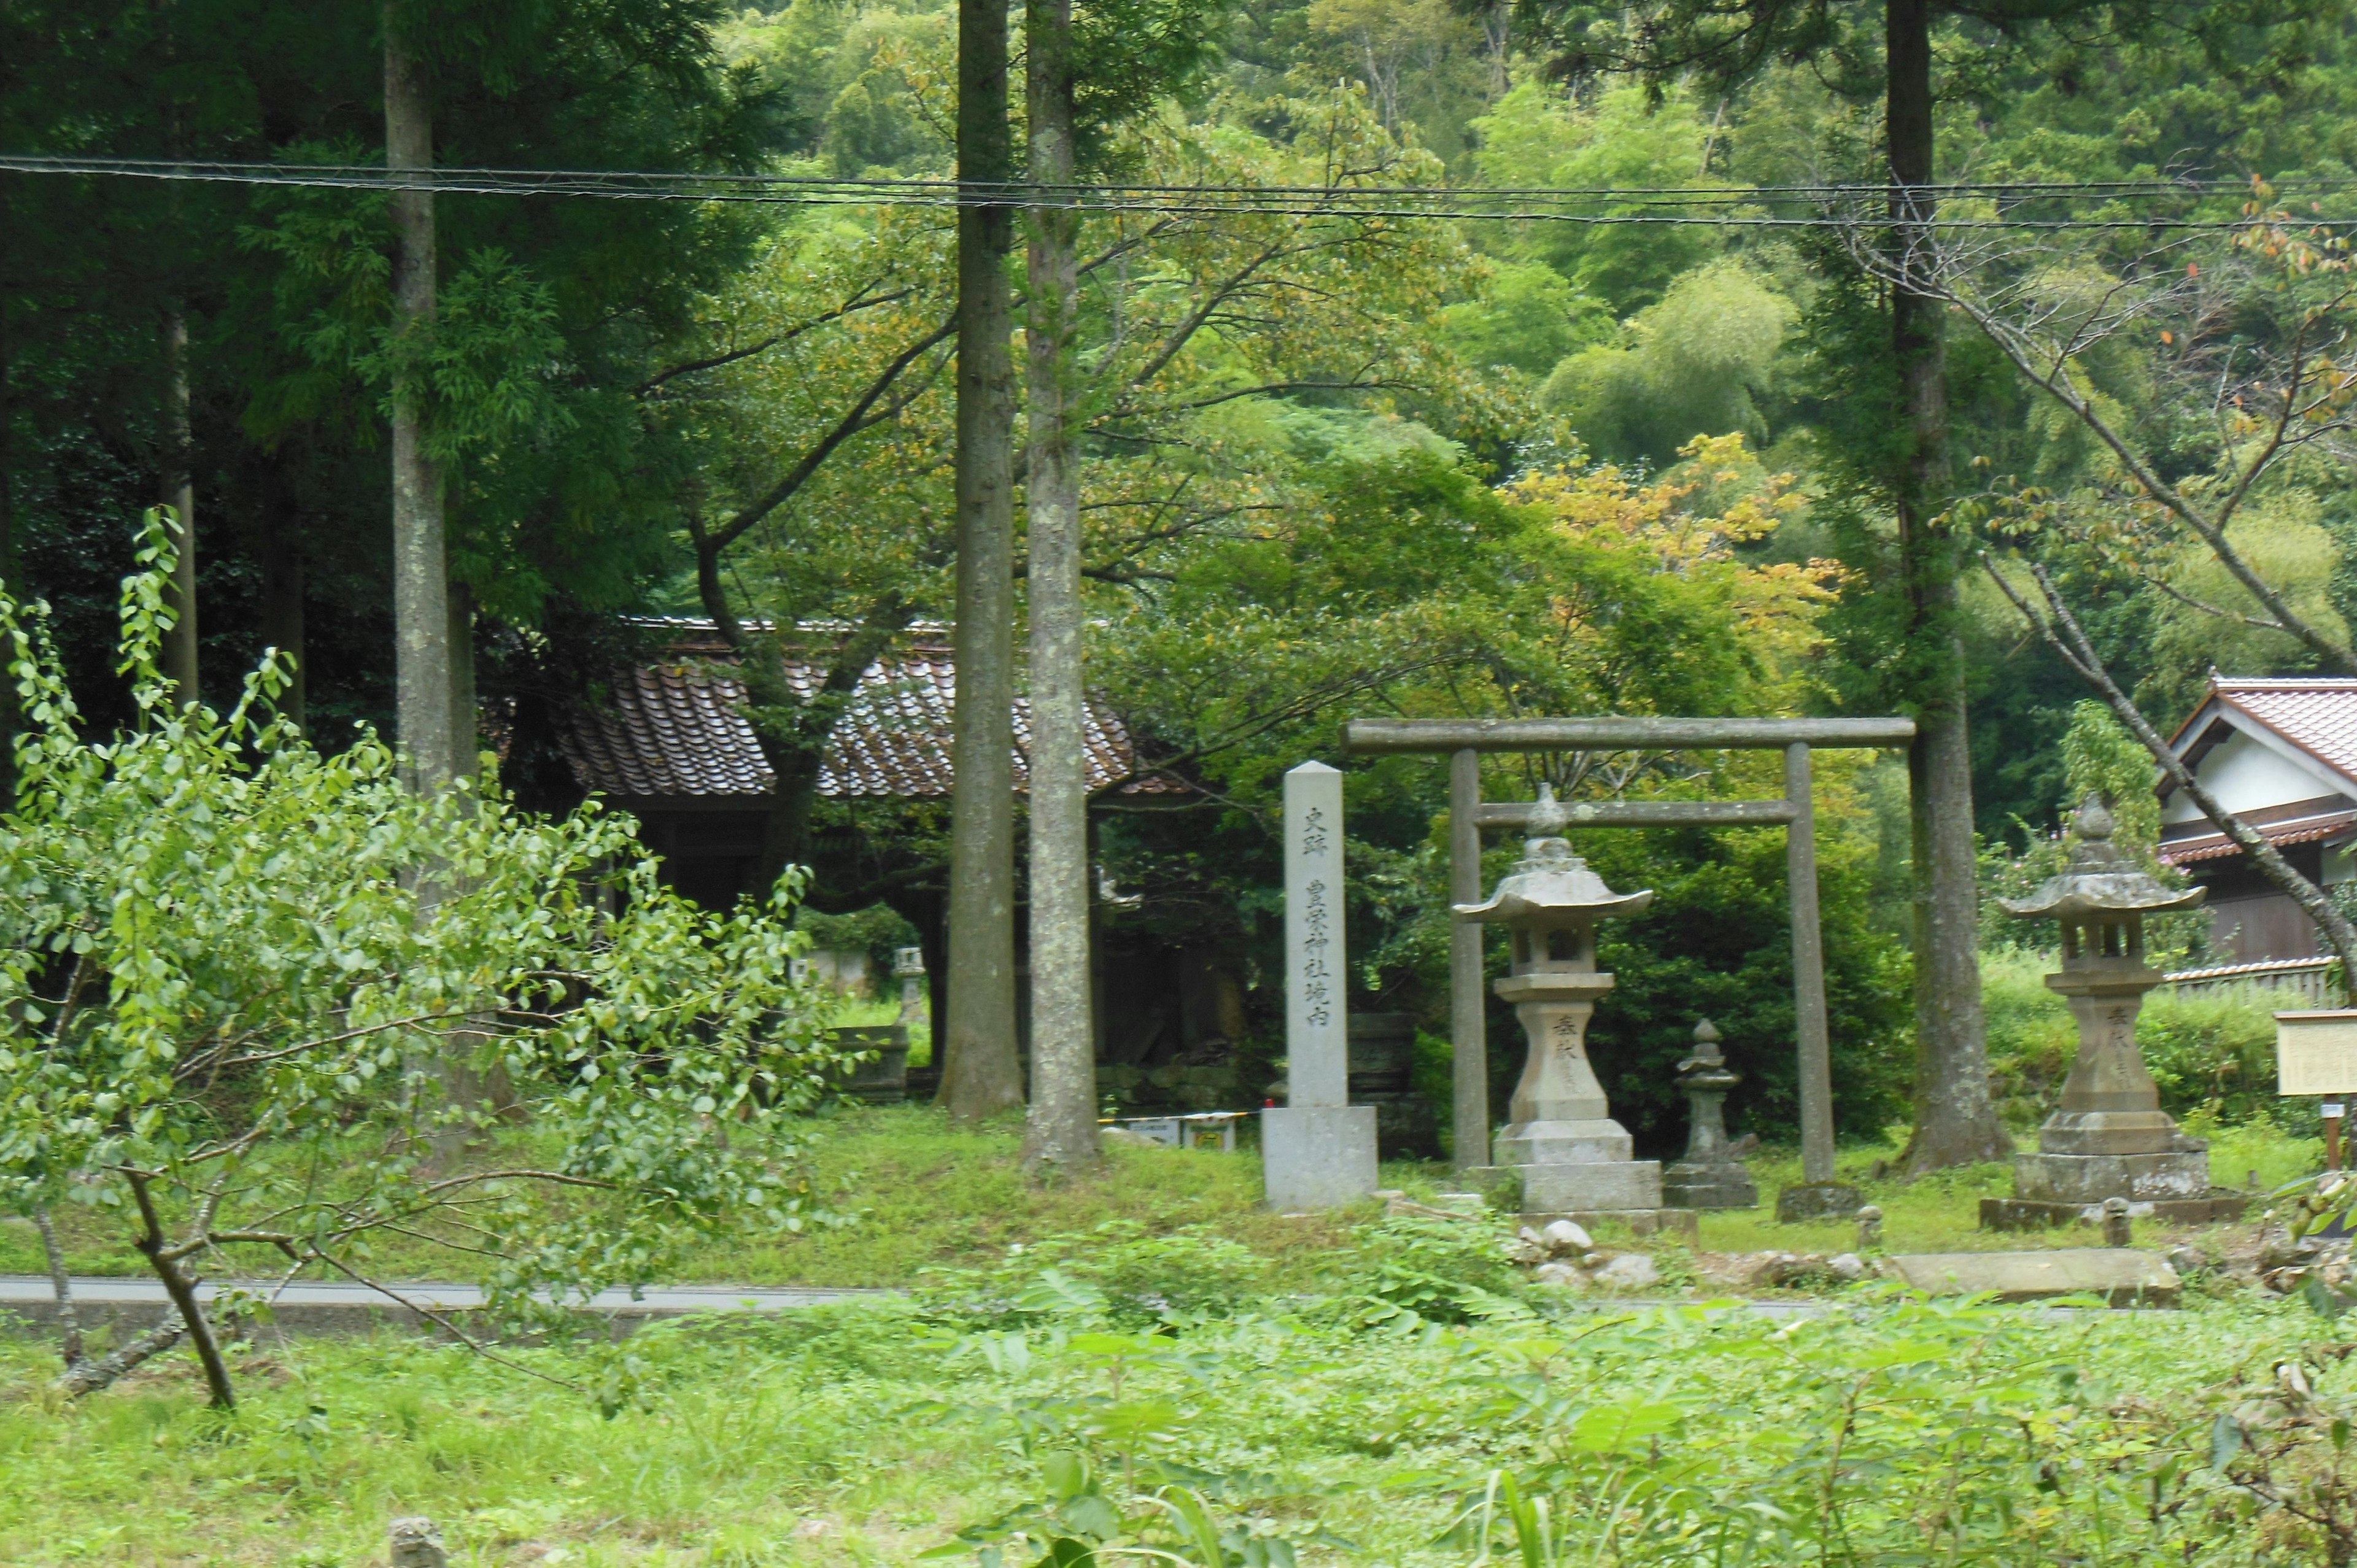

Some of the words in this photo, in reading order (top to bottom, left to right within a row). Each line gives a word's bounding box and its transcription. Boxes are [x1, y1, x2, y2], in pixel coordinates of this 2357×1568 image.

[1302, 806, 1328, 857] 史跡
[1304, 879, 1331, 1026] 豊栄神社境内
